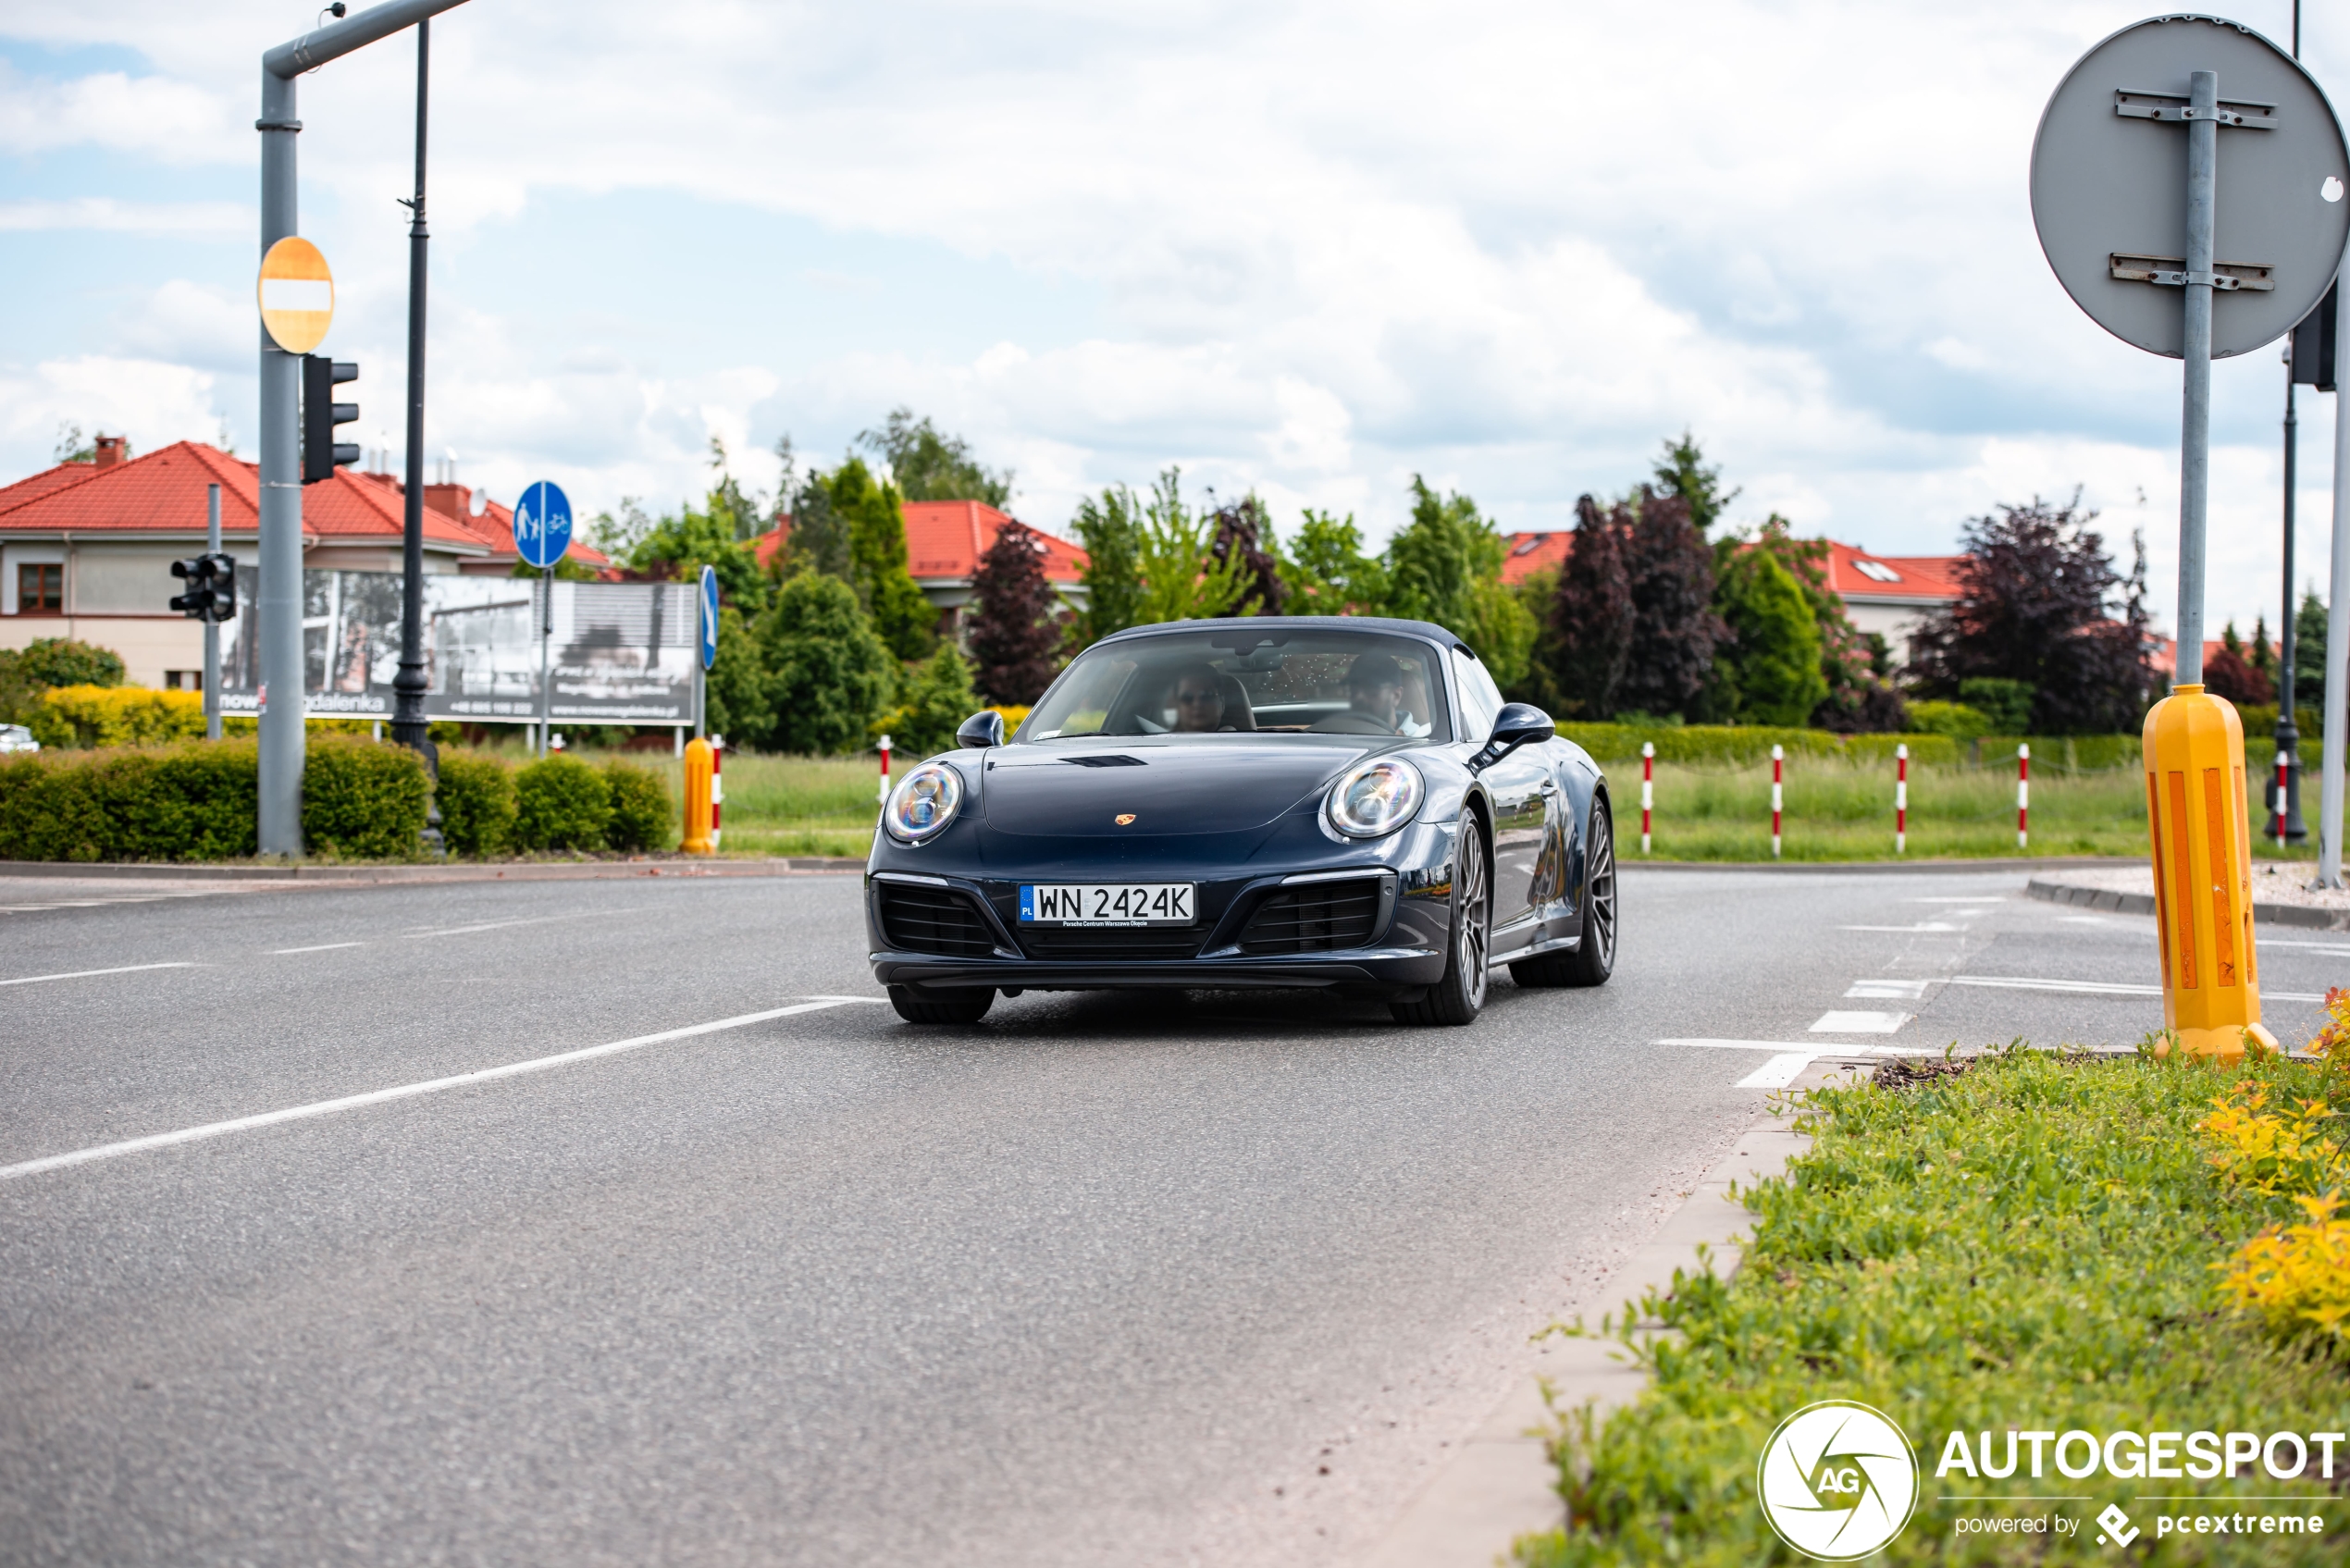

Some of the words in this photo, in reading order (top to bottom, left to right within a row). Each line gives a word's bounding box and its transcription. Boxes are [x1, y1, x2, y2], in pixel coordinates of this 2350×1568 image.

[219, 693, 260, 710] now
[303, 692, 386, 713] gdalenka
[1022, 907, 1033, 916] PL
[1039, 889, 1082, 918] WN
[1094, 887, 1190, 918] 2424K
